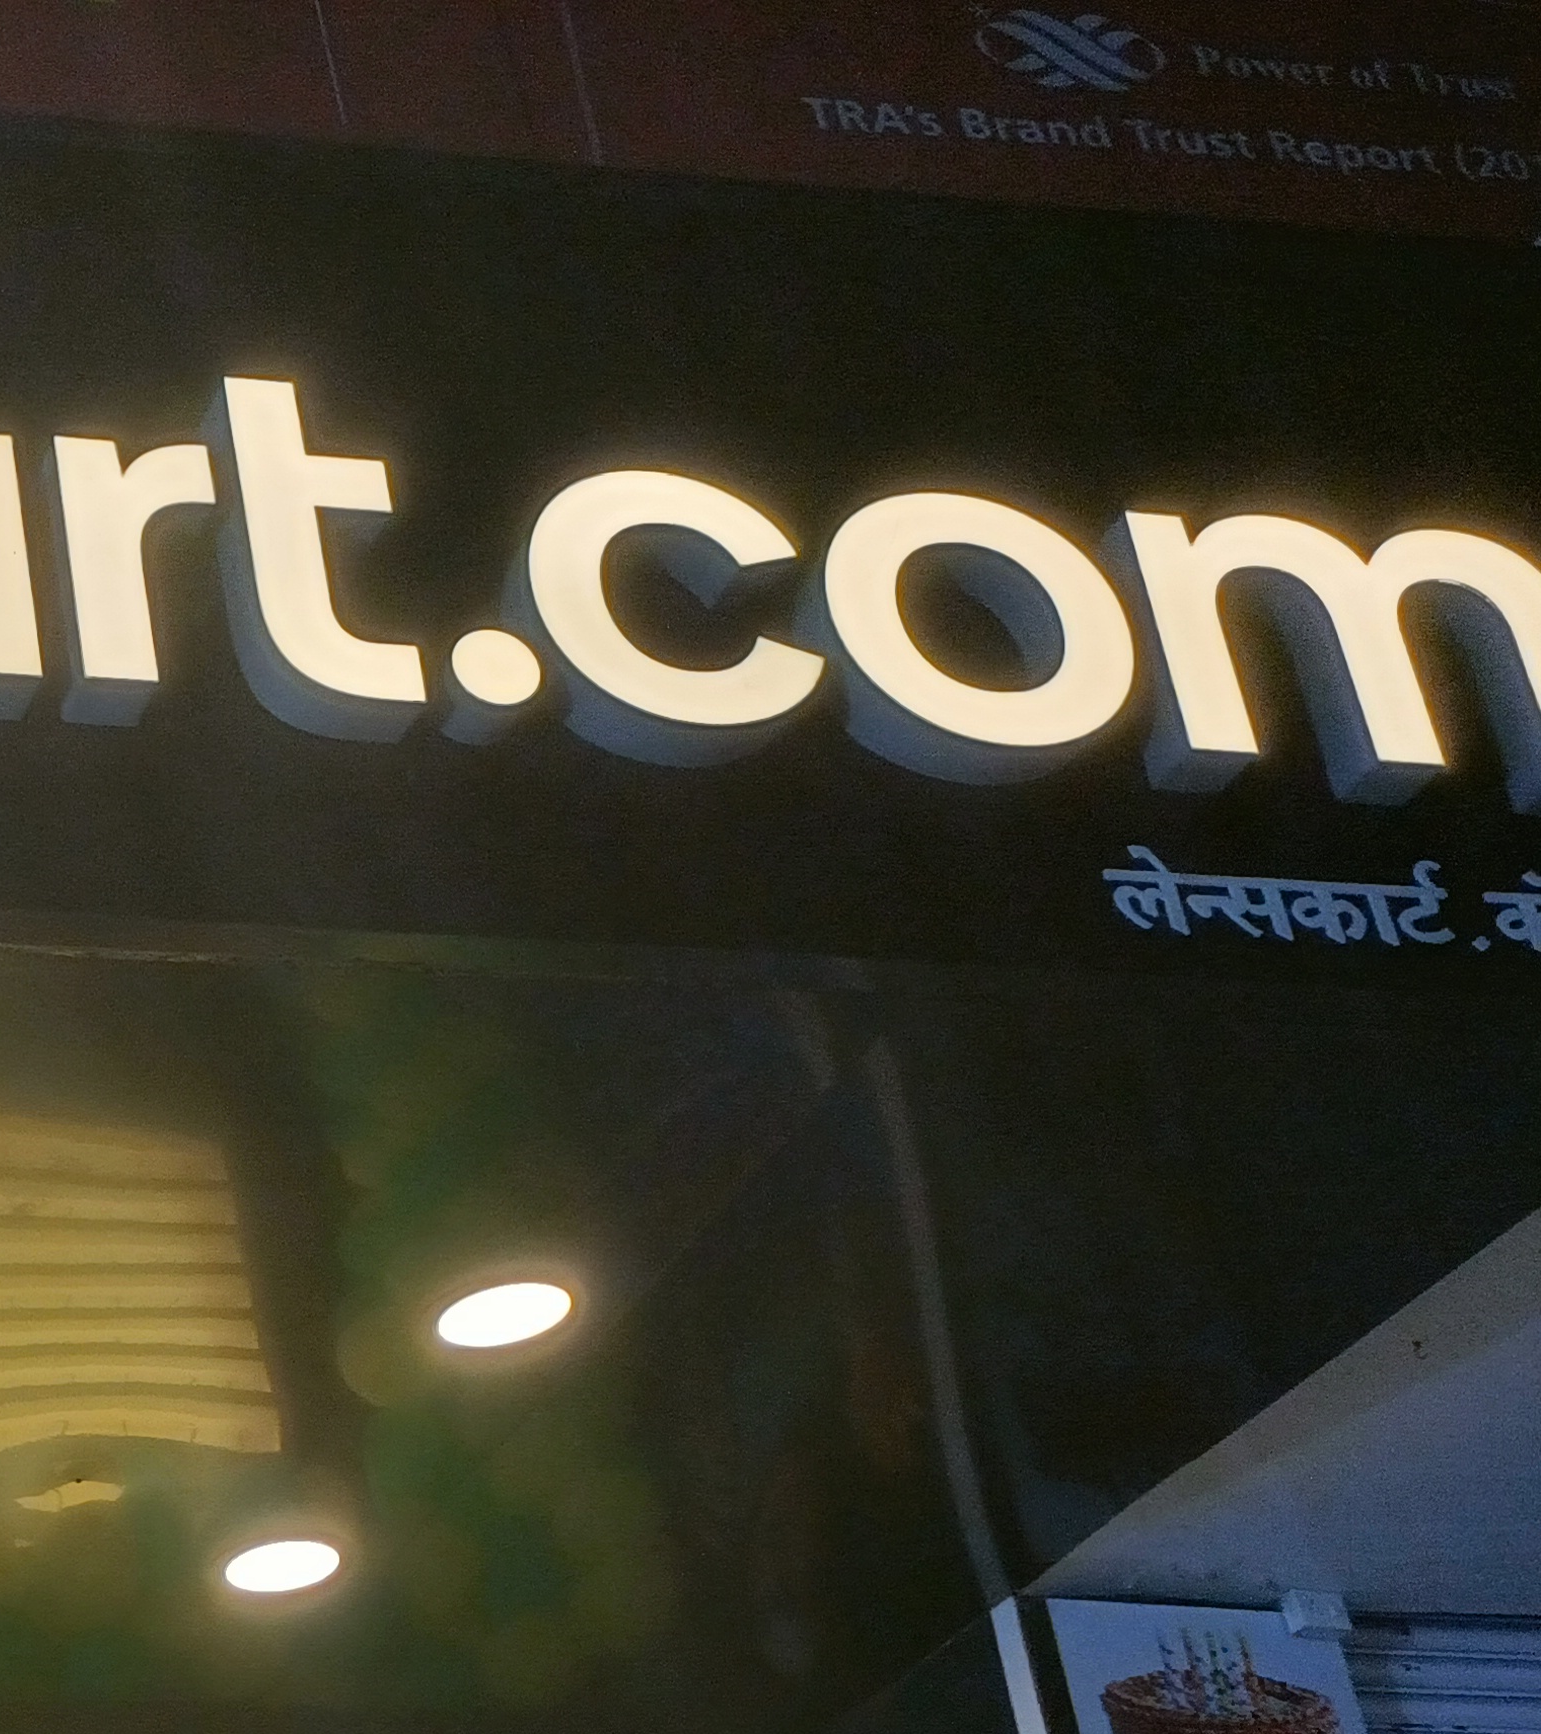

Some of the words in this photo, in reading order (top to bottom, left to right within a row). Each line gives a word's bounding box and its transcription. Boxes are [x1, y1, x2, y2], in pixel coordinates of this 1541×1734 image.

[1403, 60, 1518, 100] Trus
[800, 94, 945, 138] TRA's
[957, 105, 1112, 151] Brand
[1121, 115, 1258, 161] Trust
[1266, 129, 1438, 176] Report
